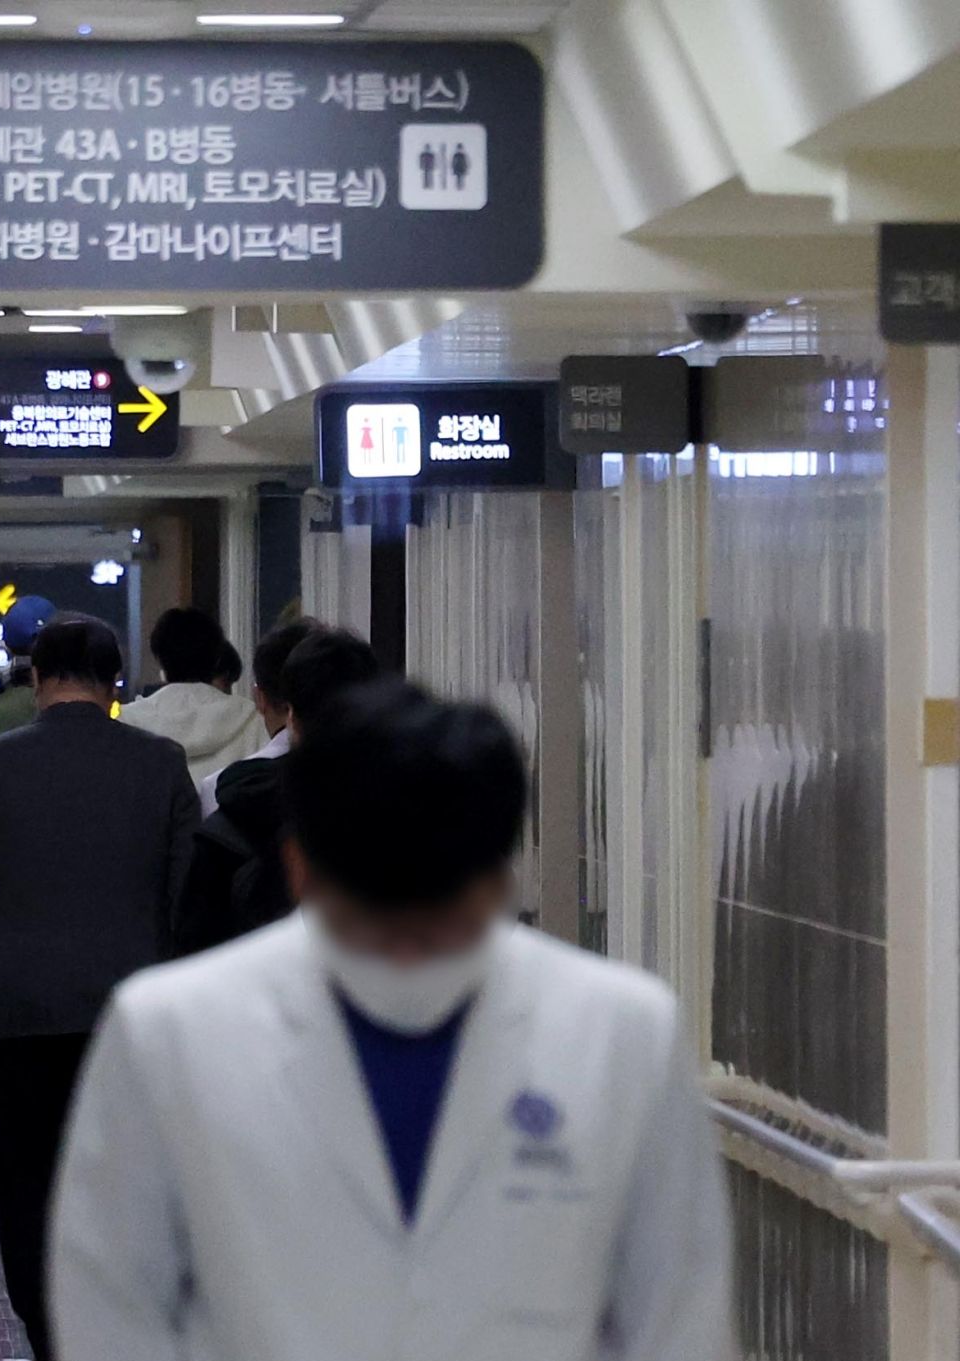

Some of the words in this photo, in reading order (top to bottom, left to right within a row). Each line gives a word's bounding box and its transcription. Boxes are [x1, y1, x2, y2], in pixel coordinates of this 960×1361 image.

[202, 167, 387, 208] 토모치료실)
[438, 414, 500, 441] 화장실
[429, 442, 510, 460] Restroom
